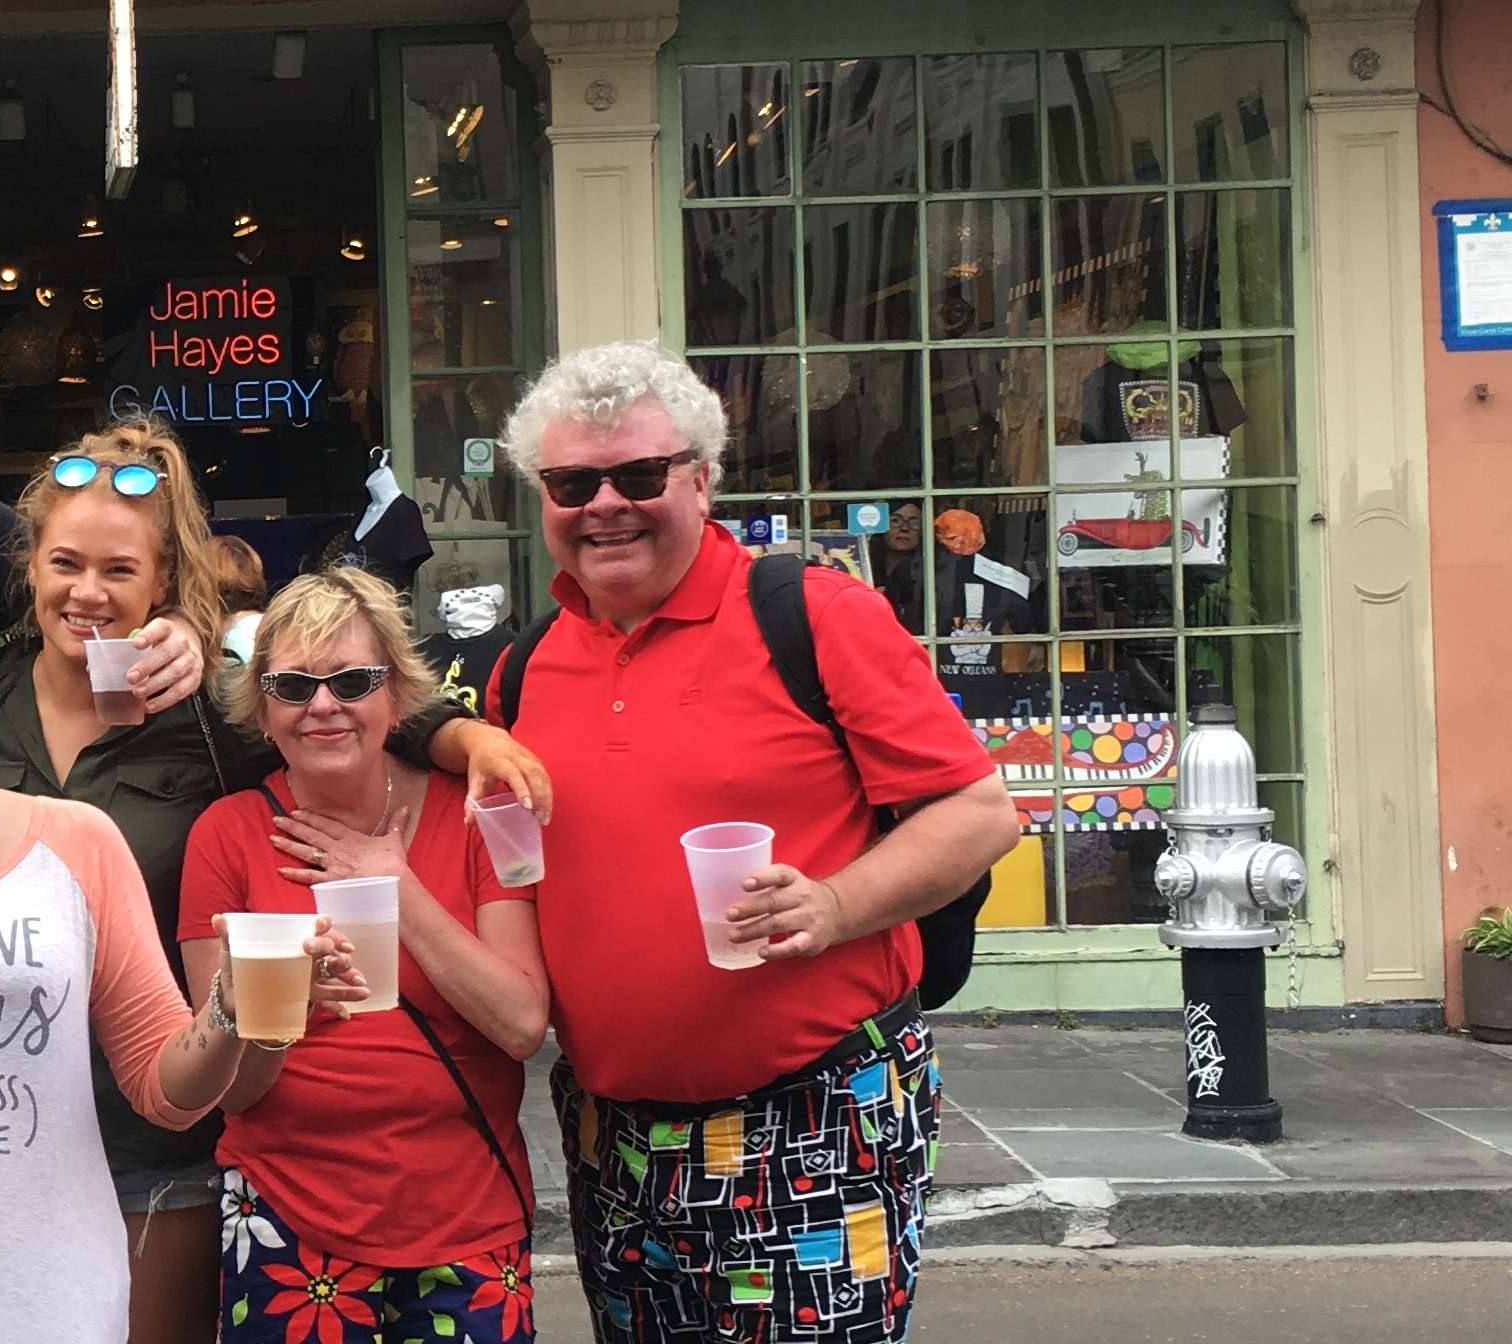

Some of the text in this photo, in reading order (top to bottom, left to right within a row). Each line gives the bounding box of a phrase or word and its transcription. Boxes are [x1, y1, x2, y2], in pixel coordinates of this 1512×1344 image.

[150, 278, 276, 321] Jamie
[150, 329, 280, 375] Hayes
[109, 379, 322, 422] GALLERY
